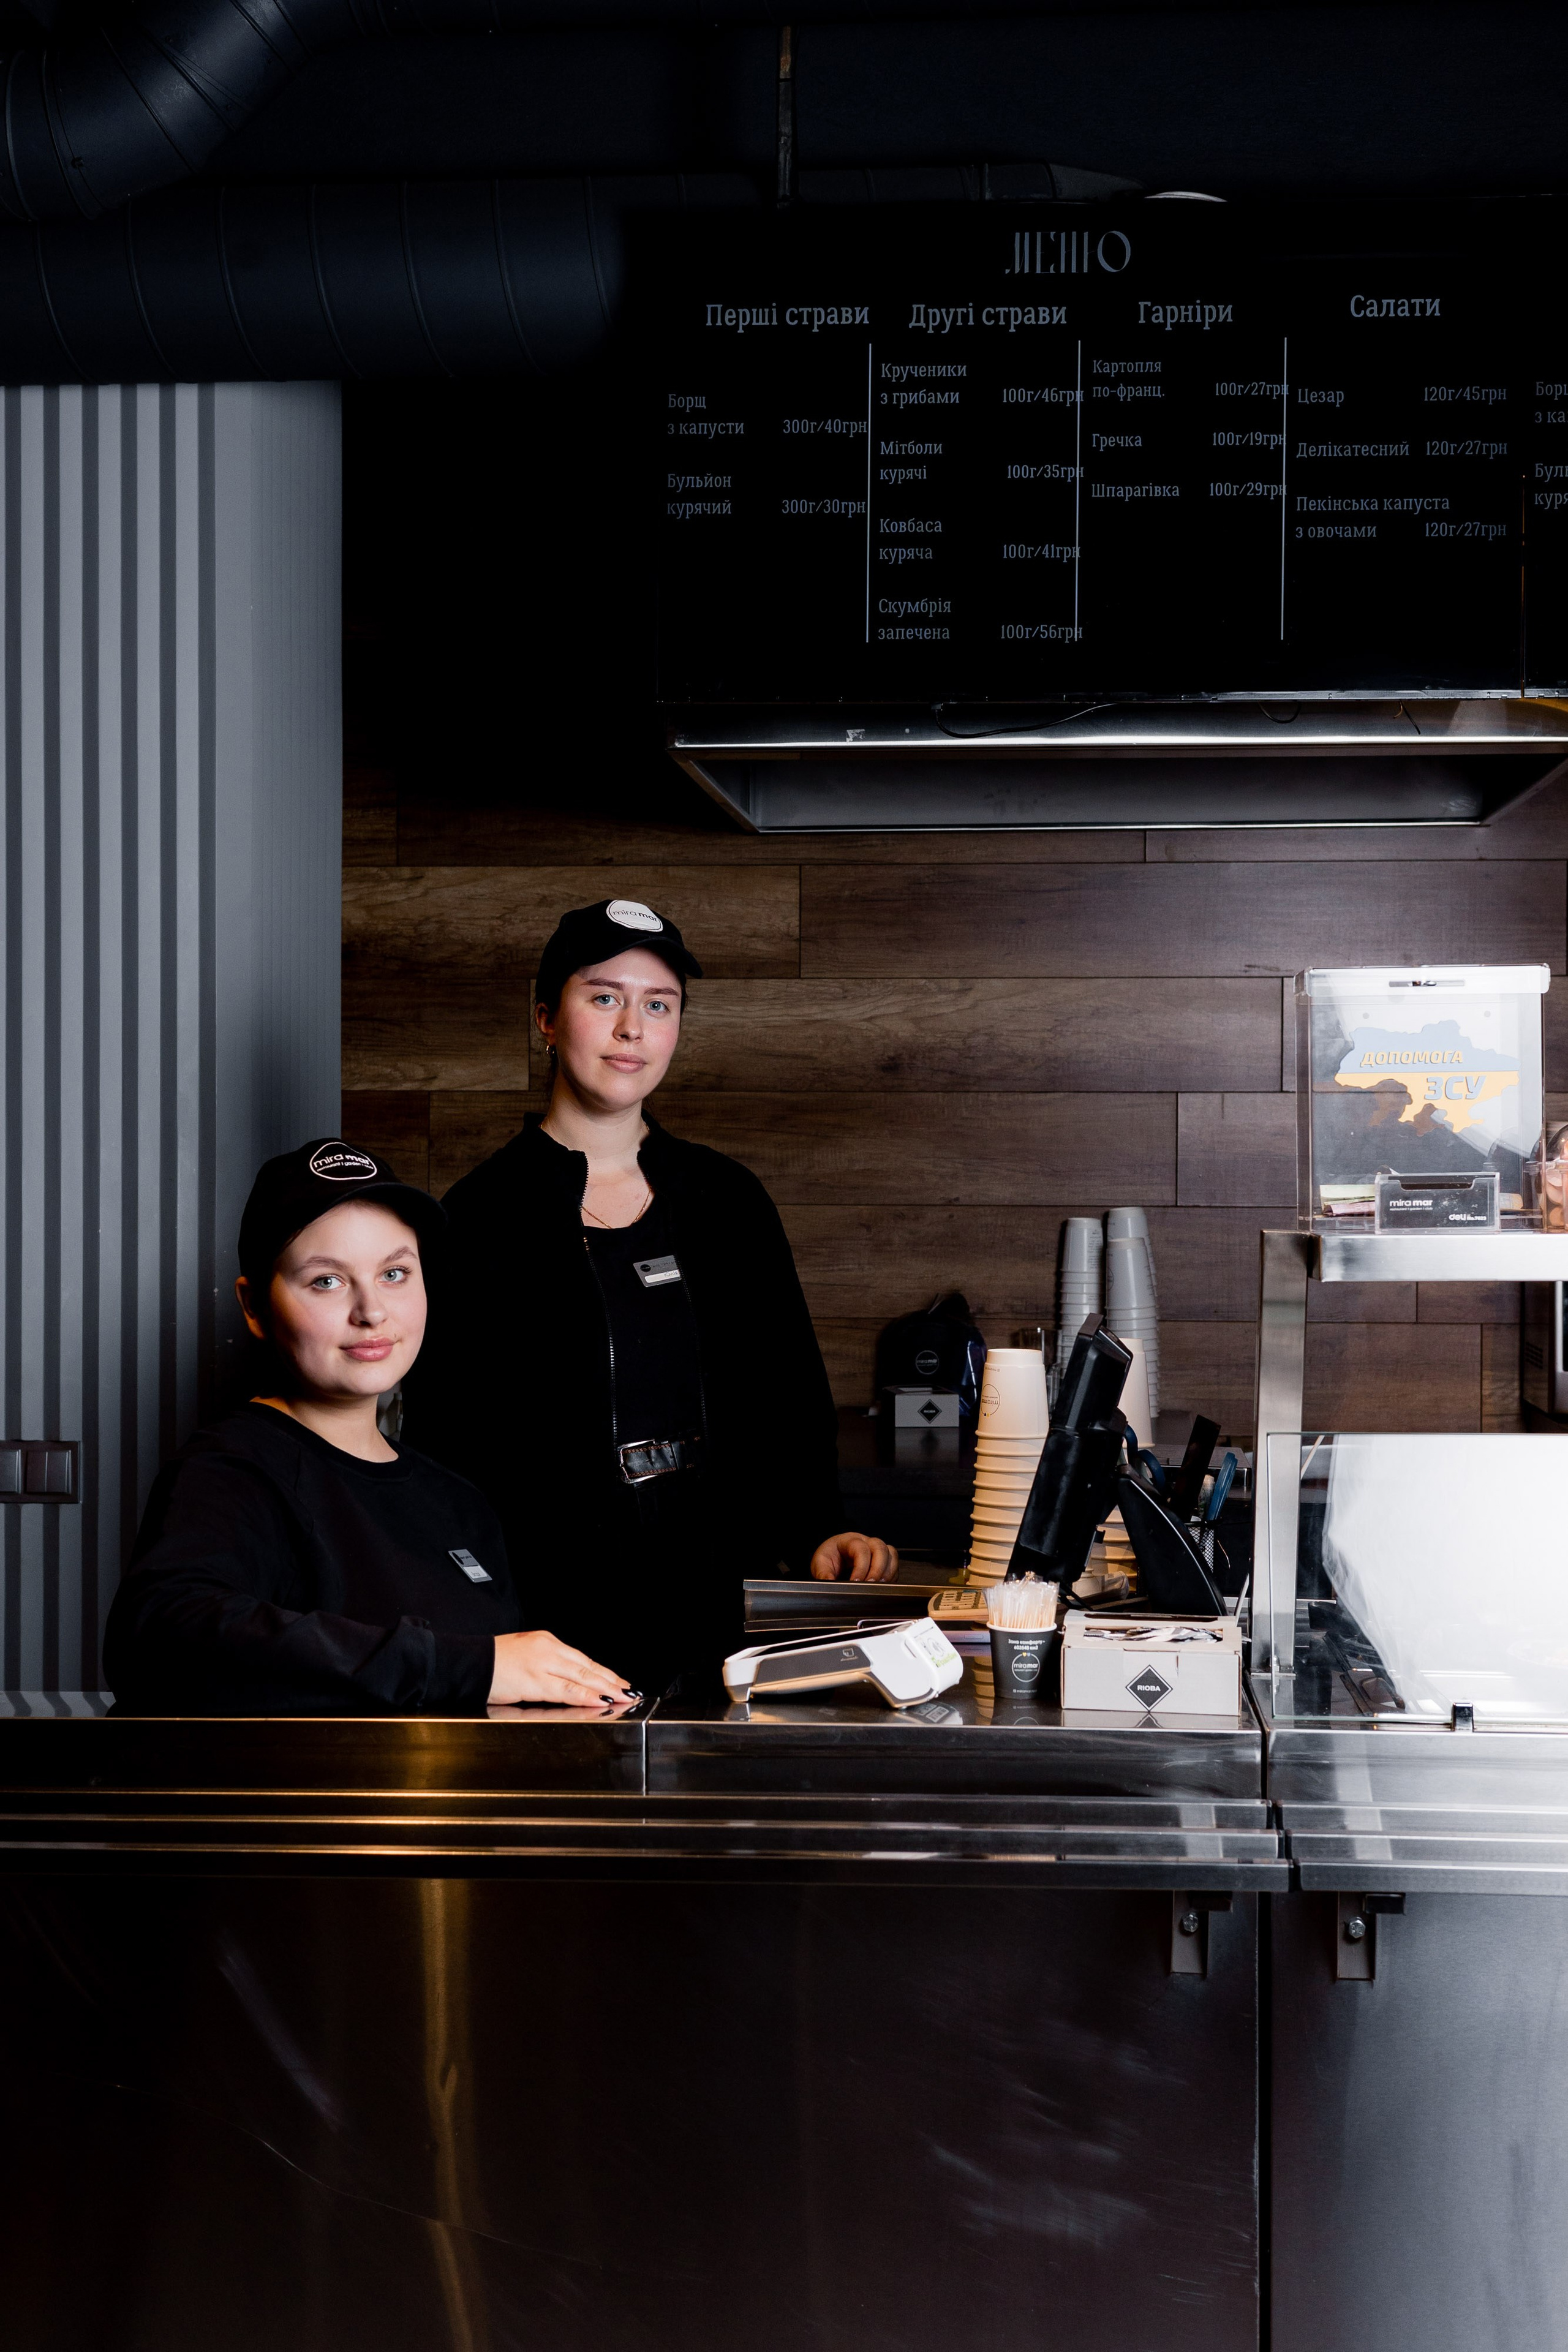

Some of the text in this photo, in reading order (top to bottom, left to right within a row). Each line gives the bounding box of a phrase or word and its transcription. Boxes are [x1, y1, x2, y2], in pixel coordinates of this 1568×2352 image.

[1005, 230, 1131, 274] МЕНЮ
[1138, 300, 1233, 331] Гарніри
[1350, 295, 1441, 318] Салати
[706, 303, 870, 333] Перші страви
[908, 302, 1067, 334] Другі страви
[881, 363, 967, 383] Крученики
[1093, 360, 1162, 377] Картопля
[880, 388, 960, 409] з грибами
[1092, 383, 1165, 401] по-франц.
[1297, 388, 1344, 407] Цезар
[1424, 386, 1507, 405] 120г/45грн
[668, 393, 706, 413] Борщ
[1535, 411, 1568, 423] з ка
[668, 422, 744, 439] з капусти
[783, 418, 867, 438] 300г/40грн
[880, 440, 943, 455] Мітболи
[1092, 433, 1142, 451] Гречка
[1295, 441, 1409, 459] Делікатесний
[1426, 440, 1507, 459] 120г/27грн
[668, 473, 731, 493] Бульйон
[880, 465, 927, 484] курячі
[1091, 482, 1180, 502] Шпарагівка
[667, 499, 732, 519] курячий
[782, 499, 866, 518] 300г/30грн
[1296, 496, 1450, 515] Пекінська капуста
[880, 518, 943, 533] Ковбаса
[1295, 526, 1377, 538] з овочами
[1425, 521, 1506, 541] 120г/27грн
[879, 548, 933, 565] куряча
[878, 597, 951, 618] Скумбрія
[878, 627, 950, 640] запечена
[1360, 1050, 1463, 1068] ДОПОМОГА
[1424, 1076, 1487, 1100] ЗСУ
[313, 1154, 370, 1167] mira mar
